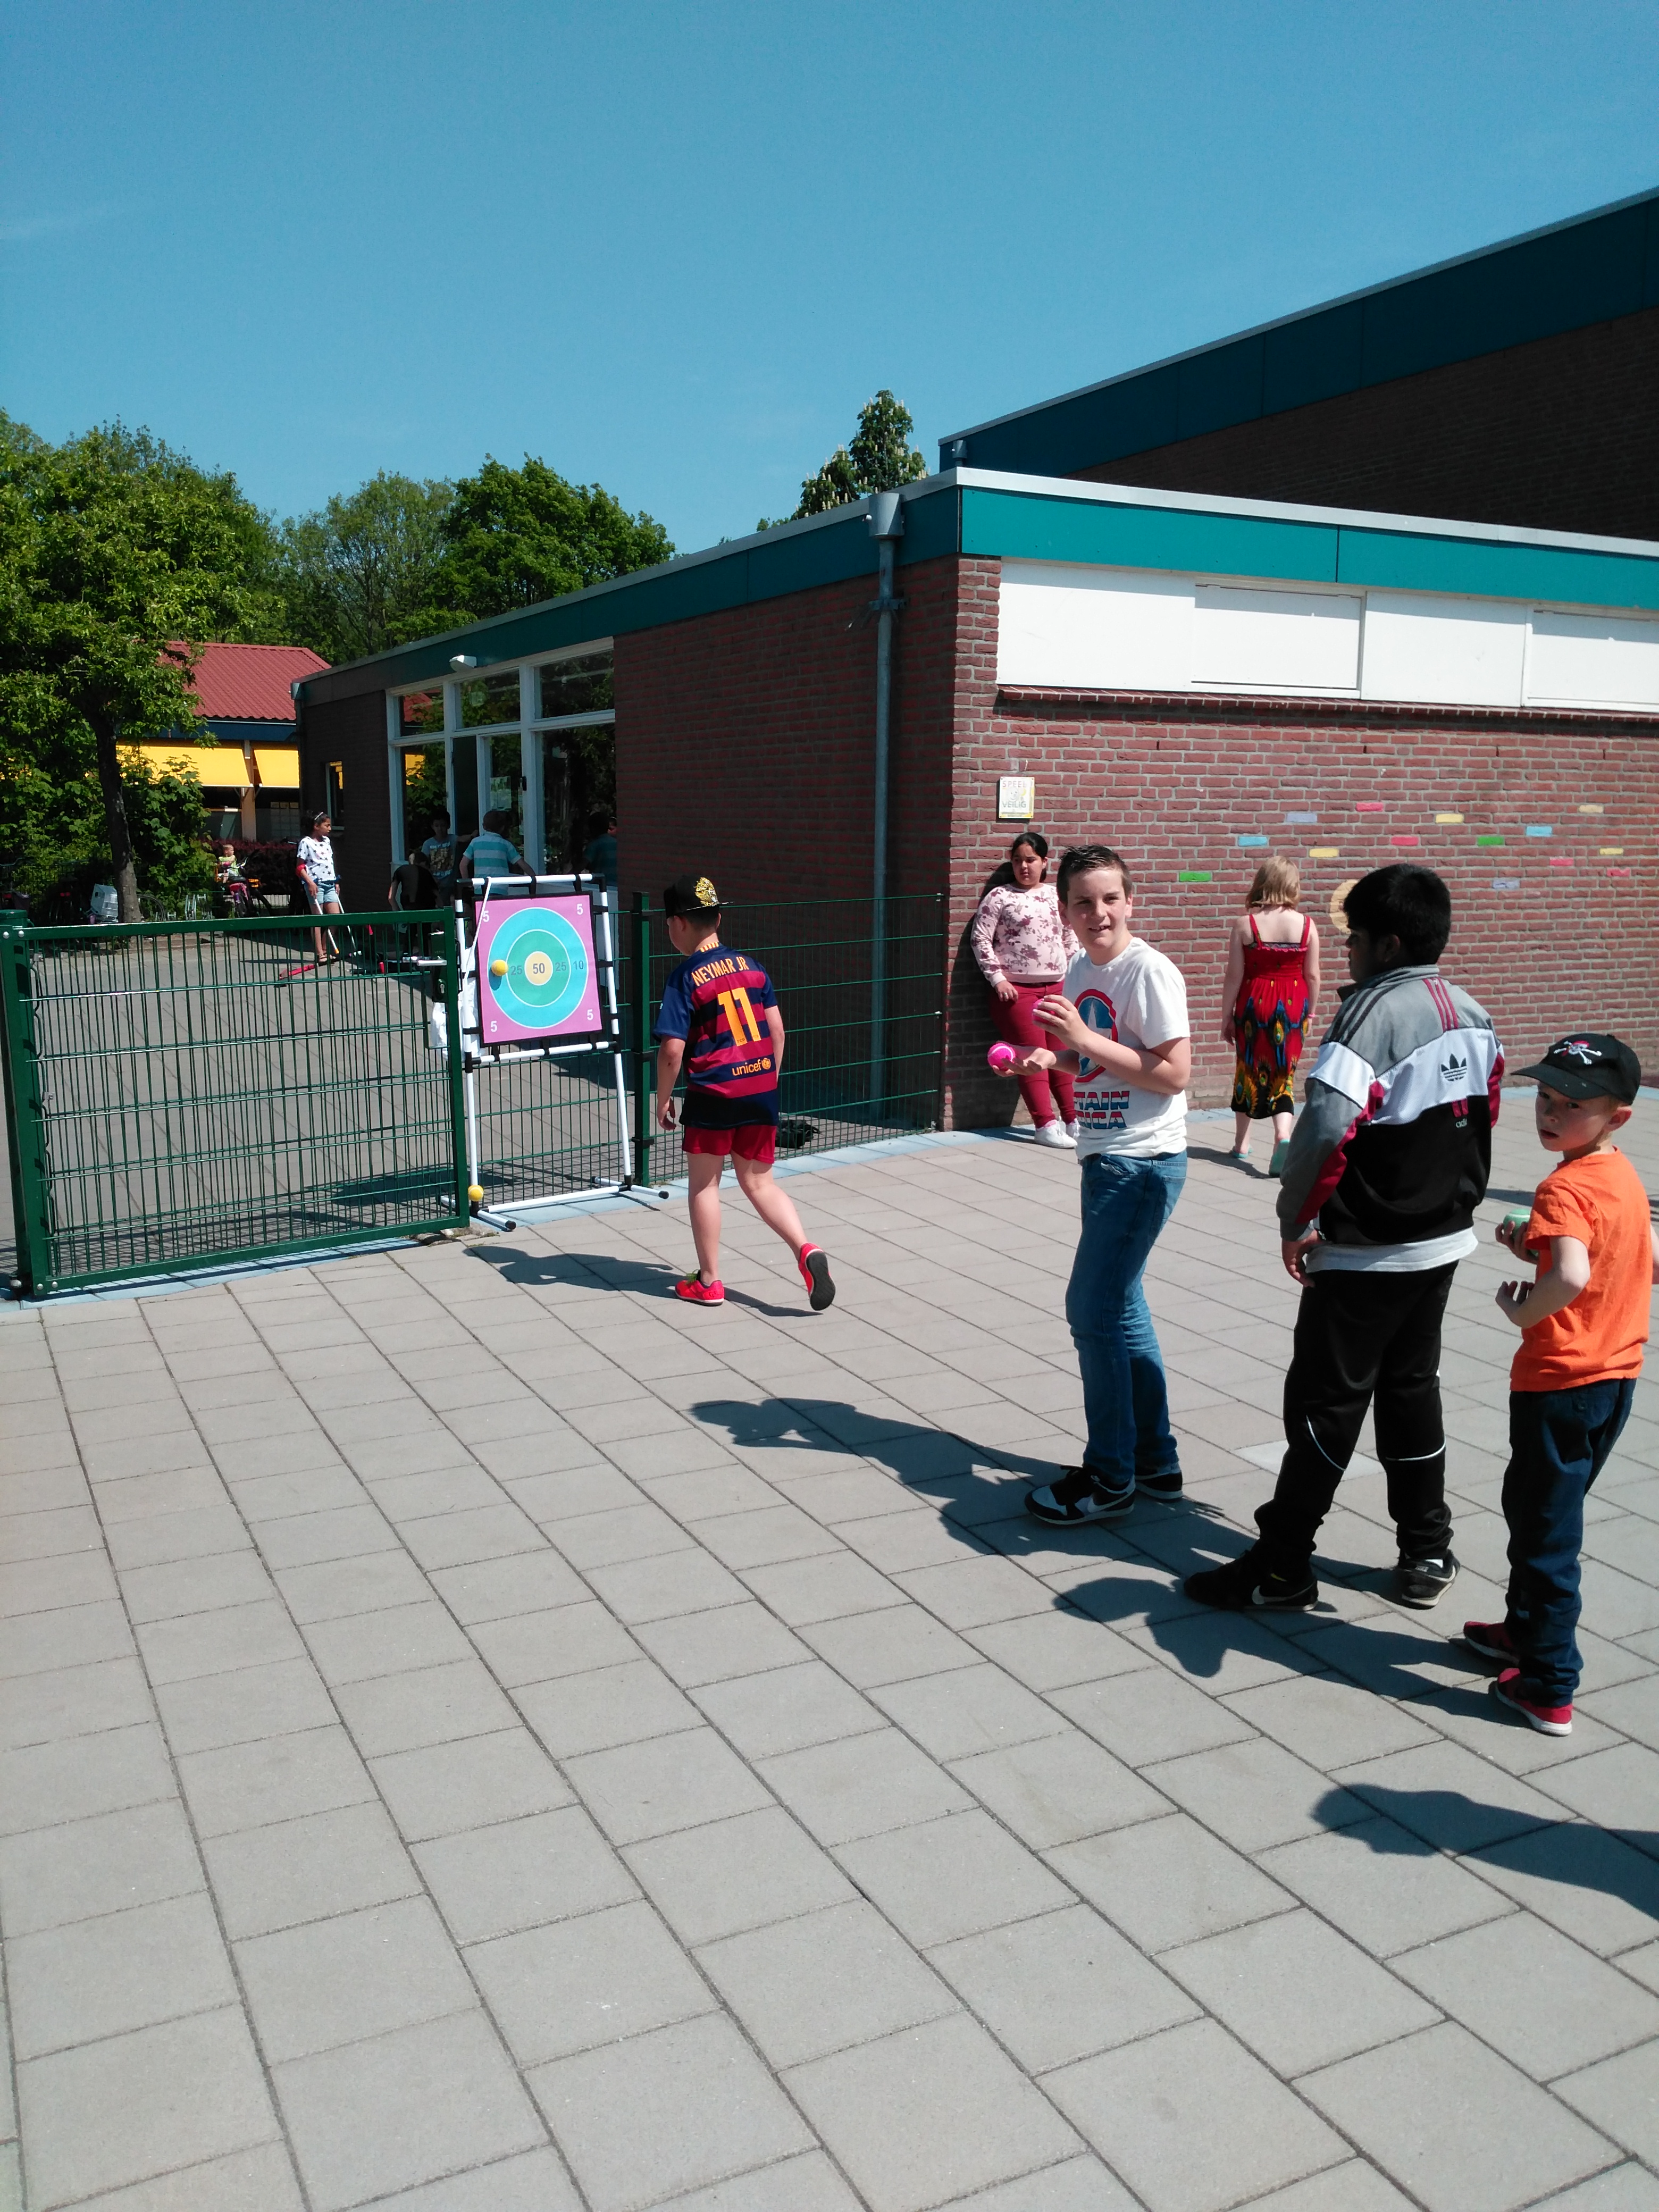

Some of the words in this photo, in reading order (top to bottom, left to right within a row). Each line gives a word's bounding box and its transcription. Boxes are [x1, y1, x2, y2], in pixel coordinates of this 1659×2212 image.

[482, 910, 490, 922] 5
[576, 903, 583, 915] 5
[510, 965, 523, 976] 25
[533, 962, 545, 974] 50
[555, 961, 566, 971] 25
[573, 960, 584, 970] 10
[691, 958, 736, 986] NEYMAR
[736, 957, 749, 970] JR
[586, 1009, 593, 1020] 5
[717, 987, 761, 1046] 11
[490, 1020, 498, 1032] 5
[732, 1059, 761, 1076] unicef
